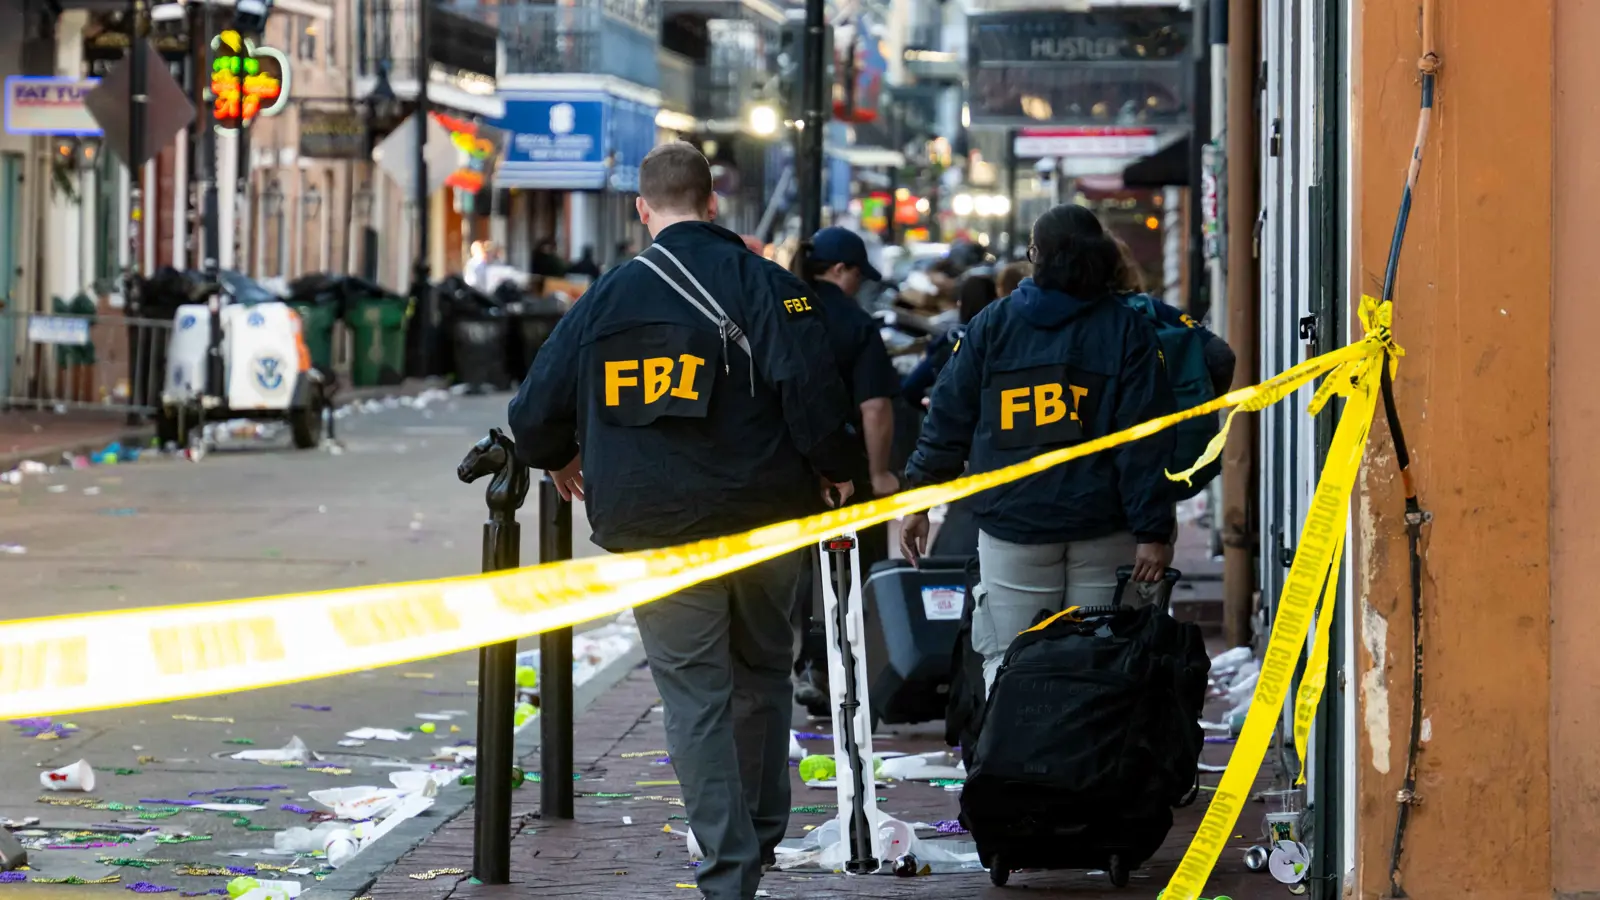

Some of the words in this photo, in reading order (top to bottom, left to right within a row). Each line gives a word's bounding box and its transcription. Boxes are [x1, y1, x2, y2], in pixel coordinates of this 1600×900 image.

[1031, 36, 1119, 59] HUSTLER
[783, 296, 812, 314] FBI
[604, 353, 706, 407] FBI
[1000, 382, 1089, 431] FBI
